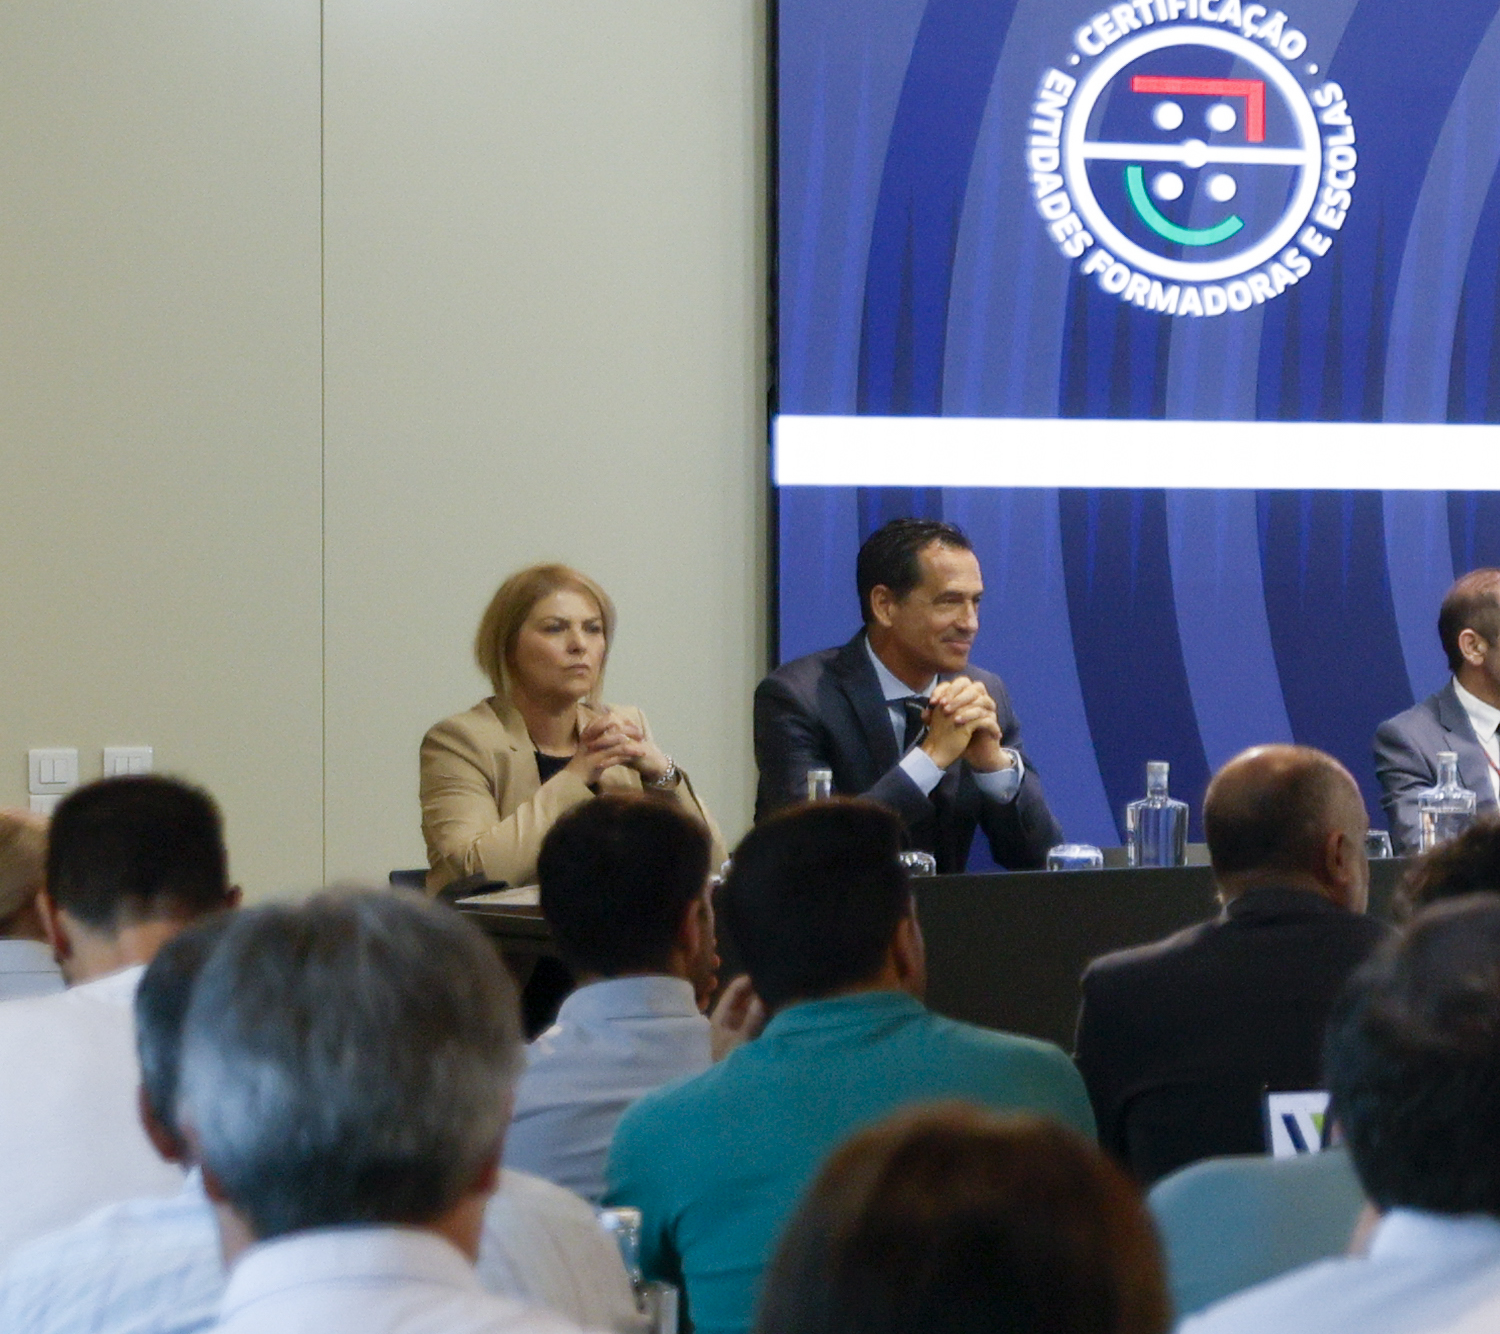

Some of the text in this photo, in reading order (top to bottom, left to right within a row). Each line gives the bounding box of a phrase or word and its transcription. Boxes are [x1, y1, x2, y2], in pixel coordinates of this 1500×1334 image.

[1029, 67, 1358, 318] ENTIDADES FORMADORAS E ESCOLAS
